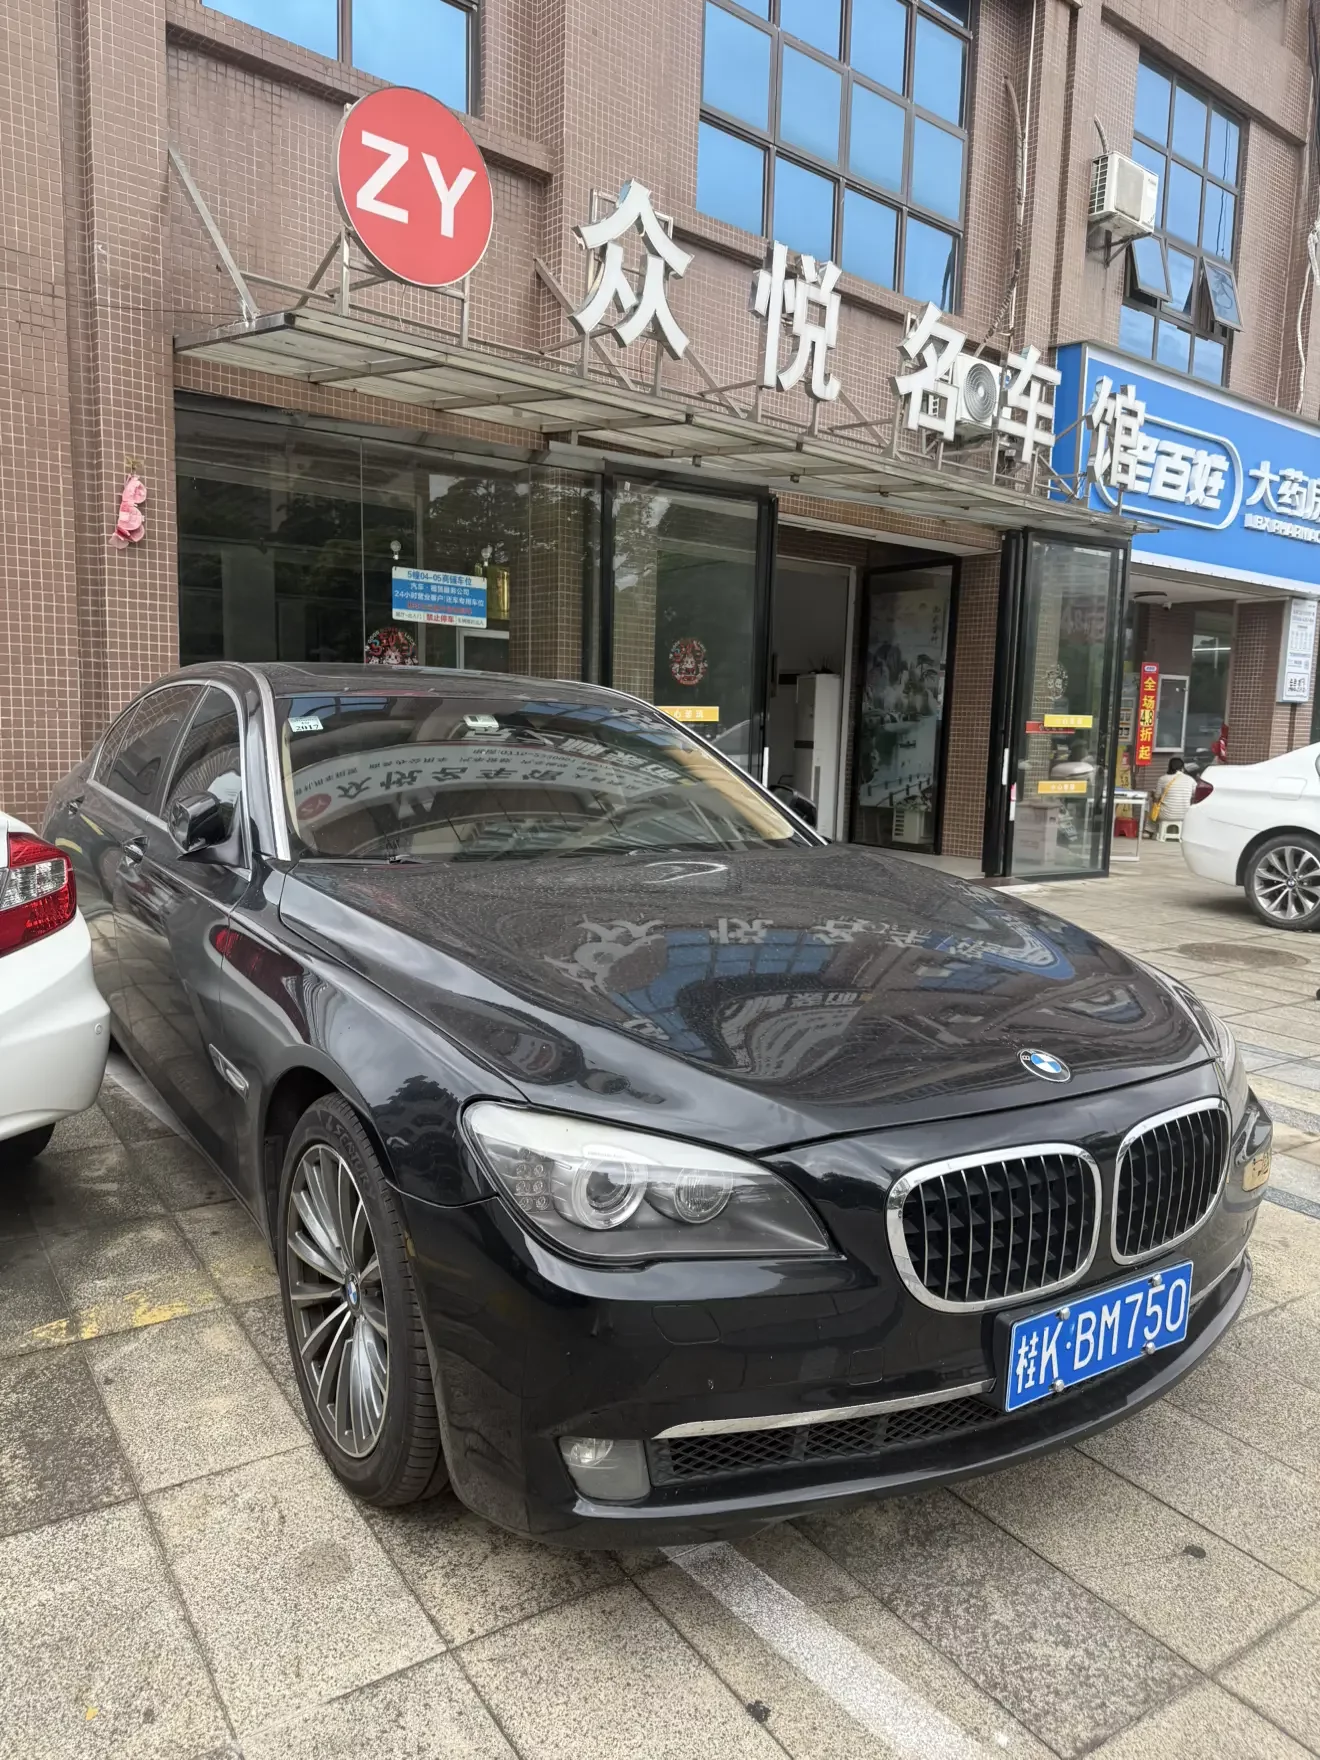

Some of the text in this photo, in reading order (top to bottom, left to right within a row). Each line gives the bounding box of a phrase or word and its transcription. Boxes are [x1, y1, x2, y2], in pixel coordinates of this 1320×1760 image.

[356, 129, 477, 240] ZY
[567, 177, 1147, 492] 众悦名车馆
